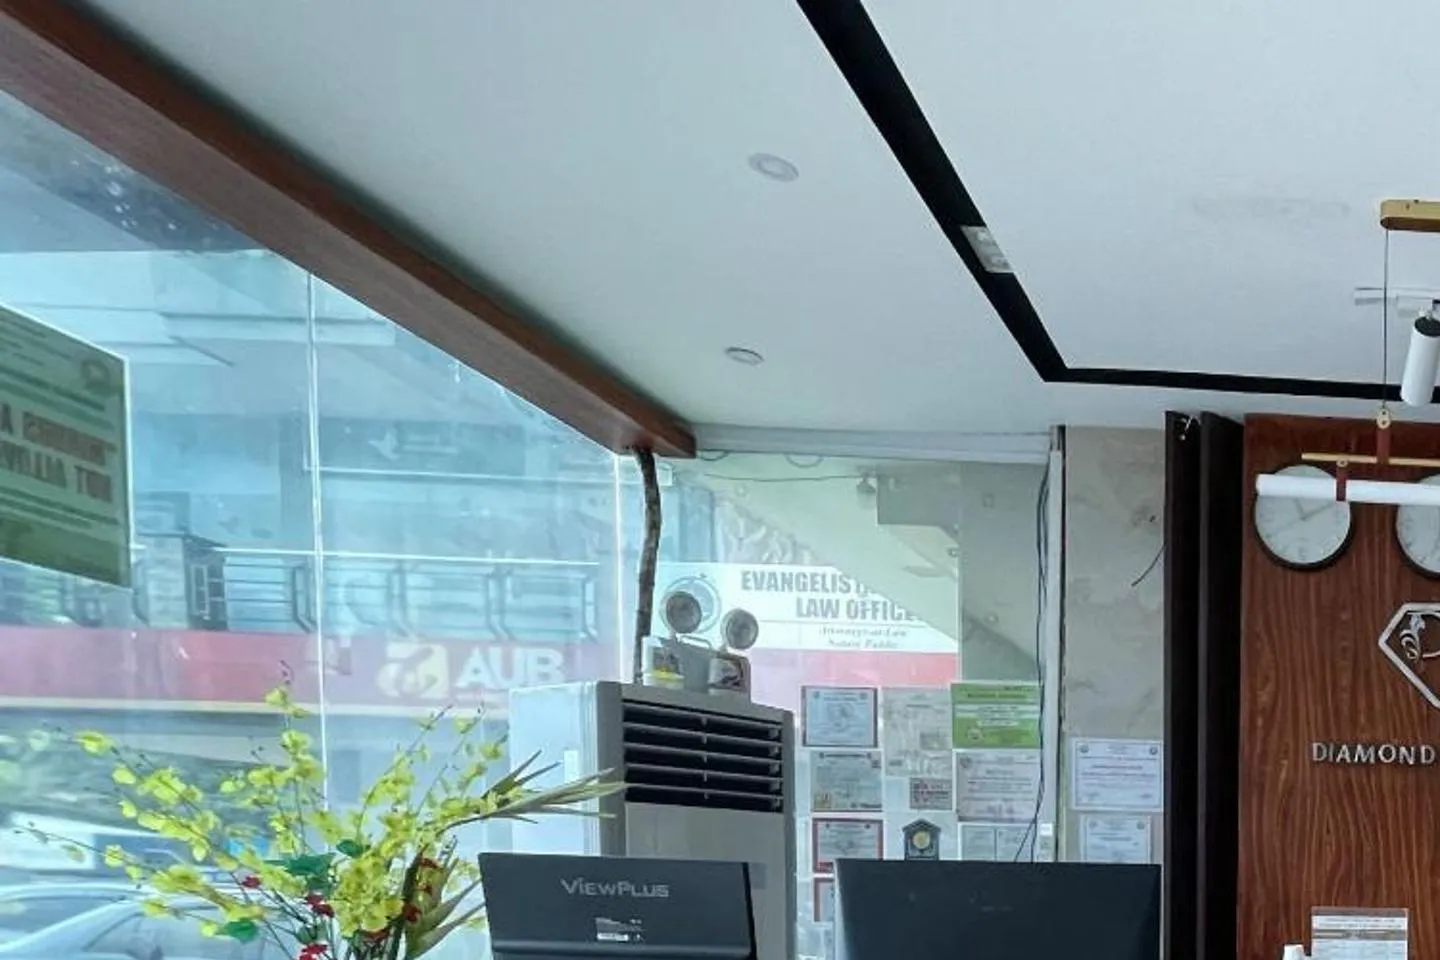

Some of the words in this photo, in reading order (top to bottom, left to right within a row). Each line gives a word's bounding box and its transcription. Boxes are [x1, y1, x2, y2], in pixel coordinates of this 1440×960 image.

[796, 599, 840, 619] LAW
[455, 645, 566, 691] AUB
[1311, 742, 1436, 765] DIAMOND
